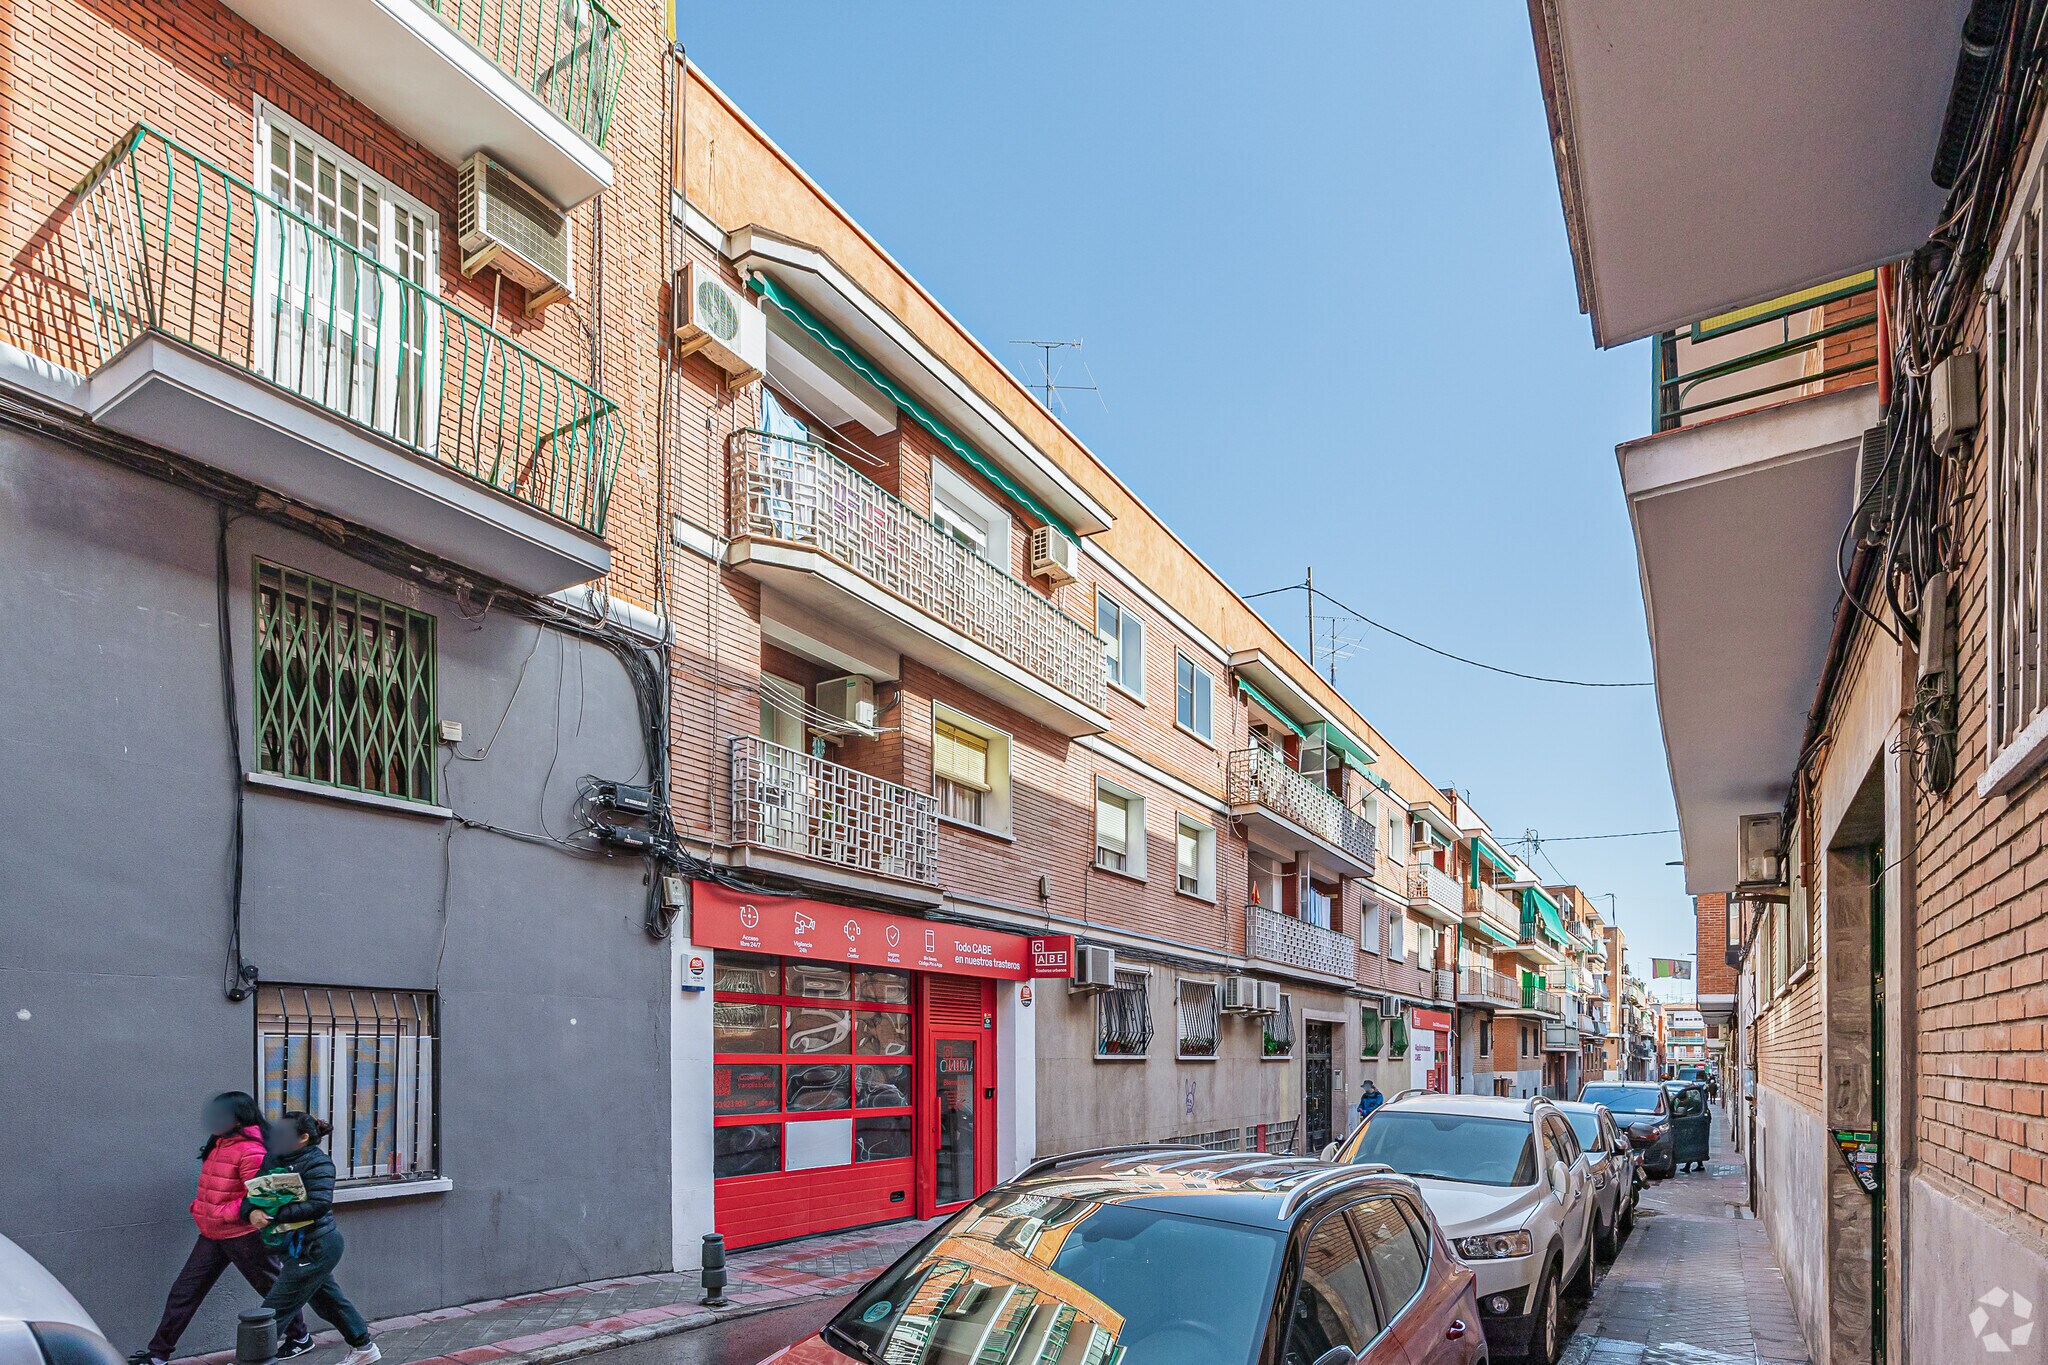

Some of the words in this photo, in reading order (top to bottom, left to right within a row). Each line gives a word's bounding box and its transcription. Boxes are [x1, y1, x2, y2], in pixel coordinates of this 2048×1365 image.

[954, 941, 971, 952] Todo
[972, 944, 992, 955] CABE
[965, 956, 993, 967] nuestros
[993, 959, 1021, 970] trasteros
